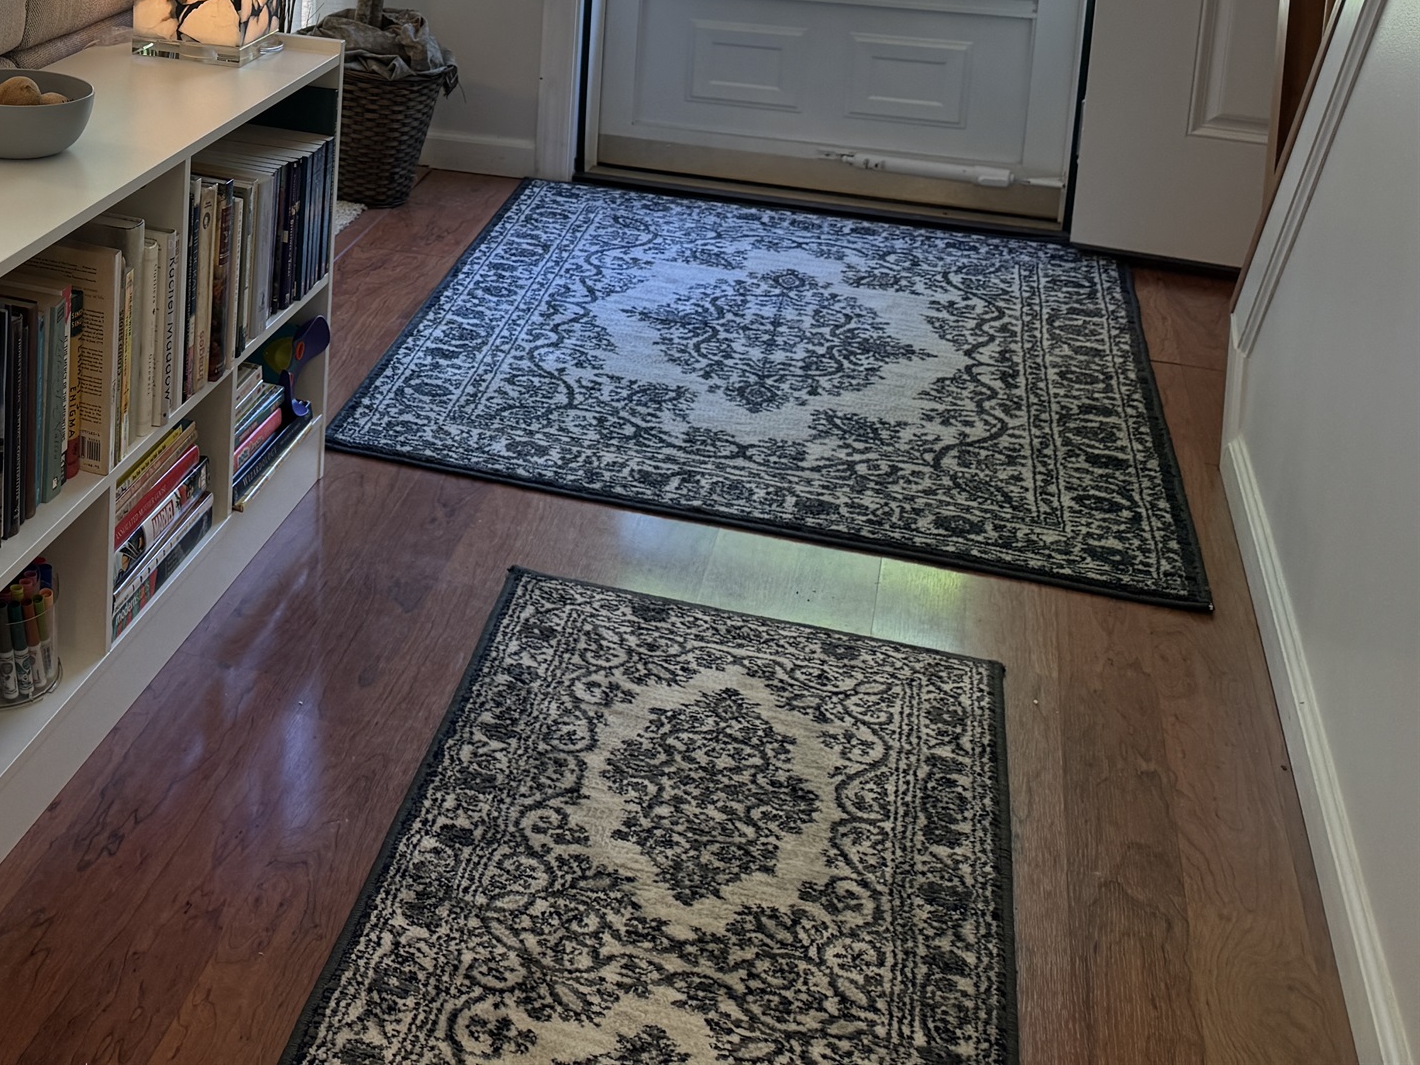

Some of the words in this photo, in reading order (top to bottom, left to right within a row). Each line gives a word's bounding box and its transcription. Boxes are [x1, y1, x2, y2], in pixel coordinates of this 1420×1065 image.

[167, 256, 175, 315] Rachel
[164, 322, 175, 406] Maddow
[69, 386, 77, 438] ENIGMA
[242, 447, 278, 487] WIZARDOLOGY
[152, 501, 174, 538] MARVEL
